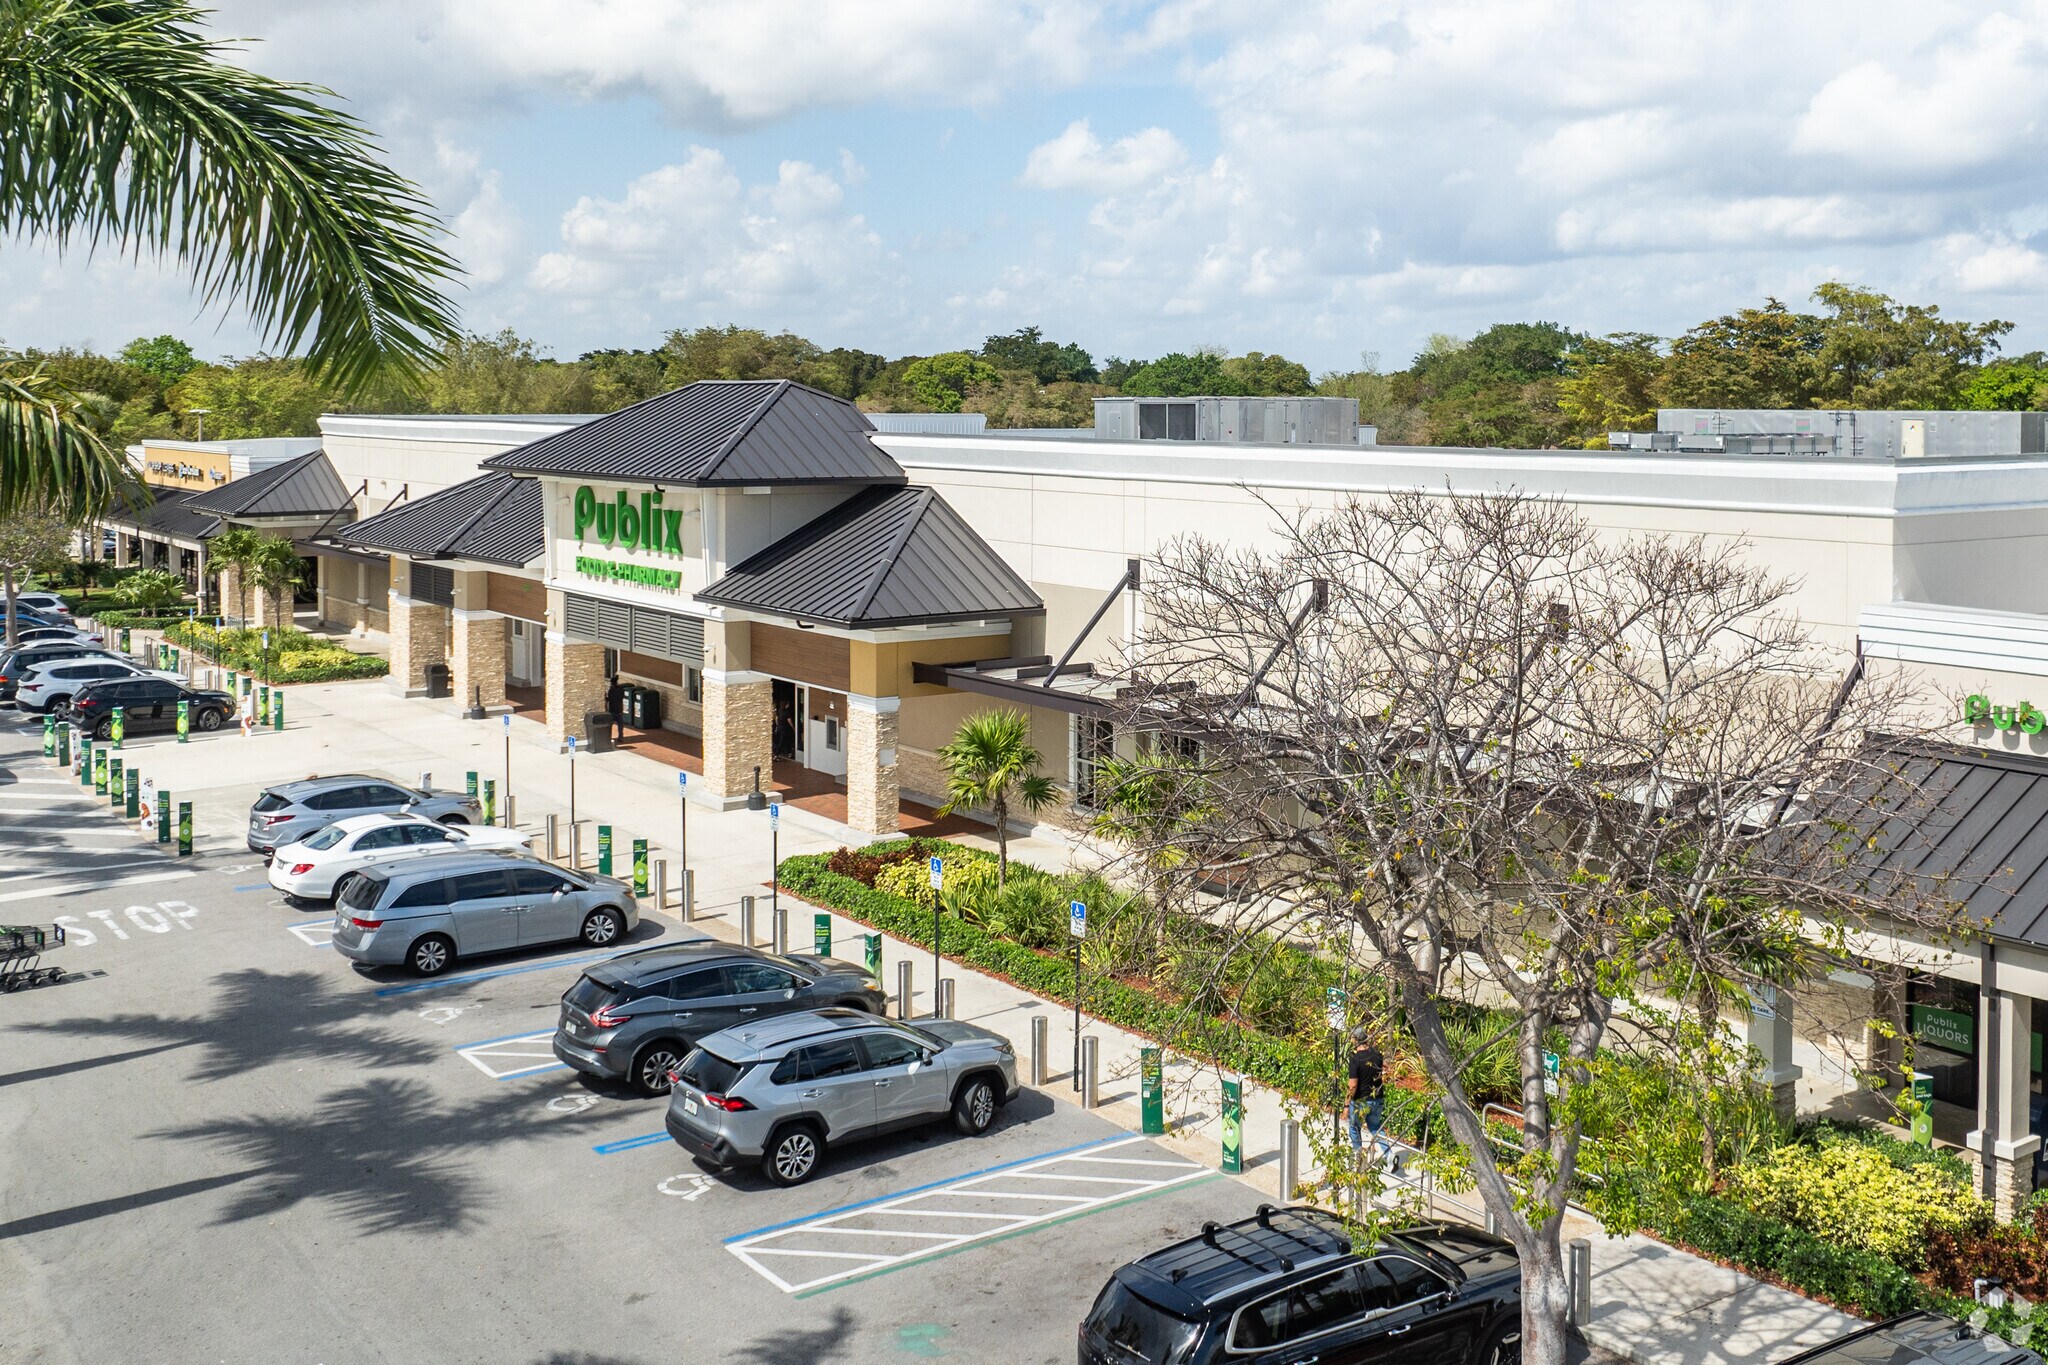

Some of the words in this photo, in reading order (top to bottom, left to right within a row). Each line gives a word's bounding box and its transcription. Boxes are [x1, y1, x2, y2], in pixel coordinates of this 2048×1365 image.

[574, 485, 684, 555] Publix
[576, 556, 608, 577] FOOD
[618, 563, 682, 589] PHARMACY
[53, 900, 200, 946] STOP
[1917, 1022, 1969, 1045] LIQUORS
[1926, 1014, 1958, 1030] Publix
